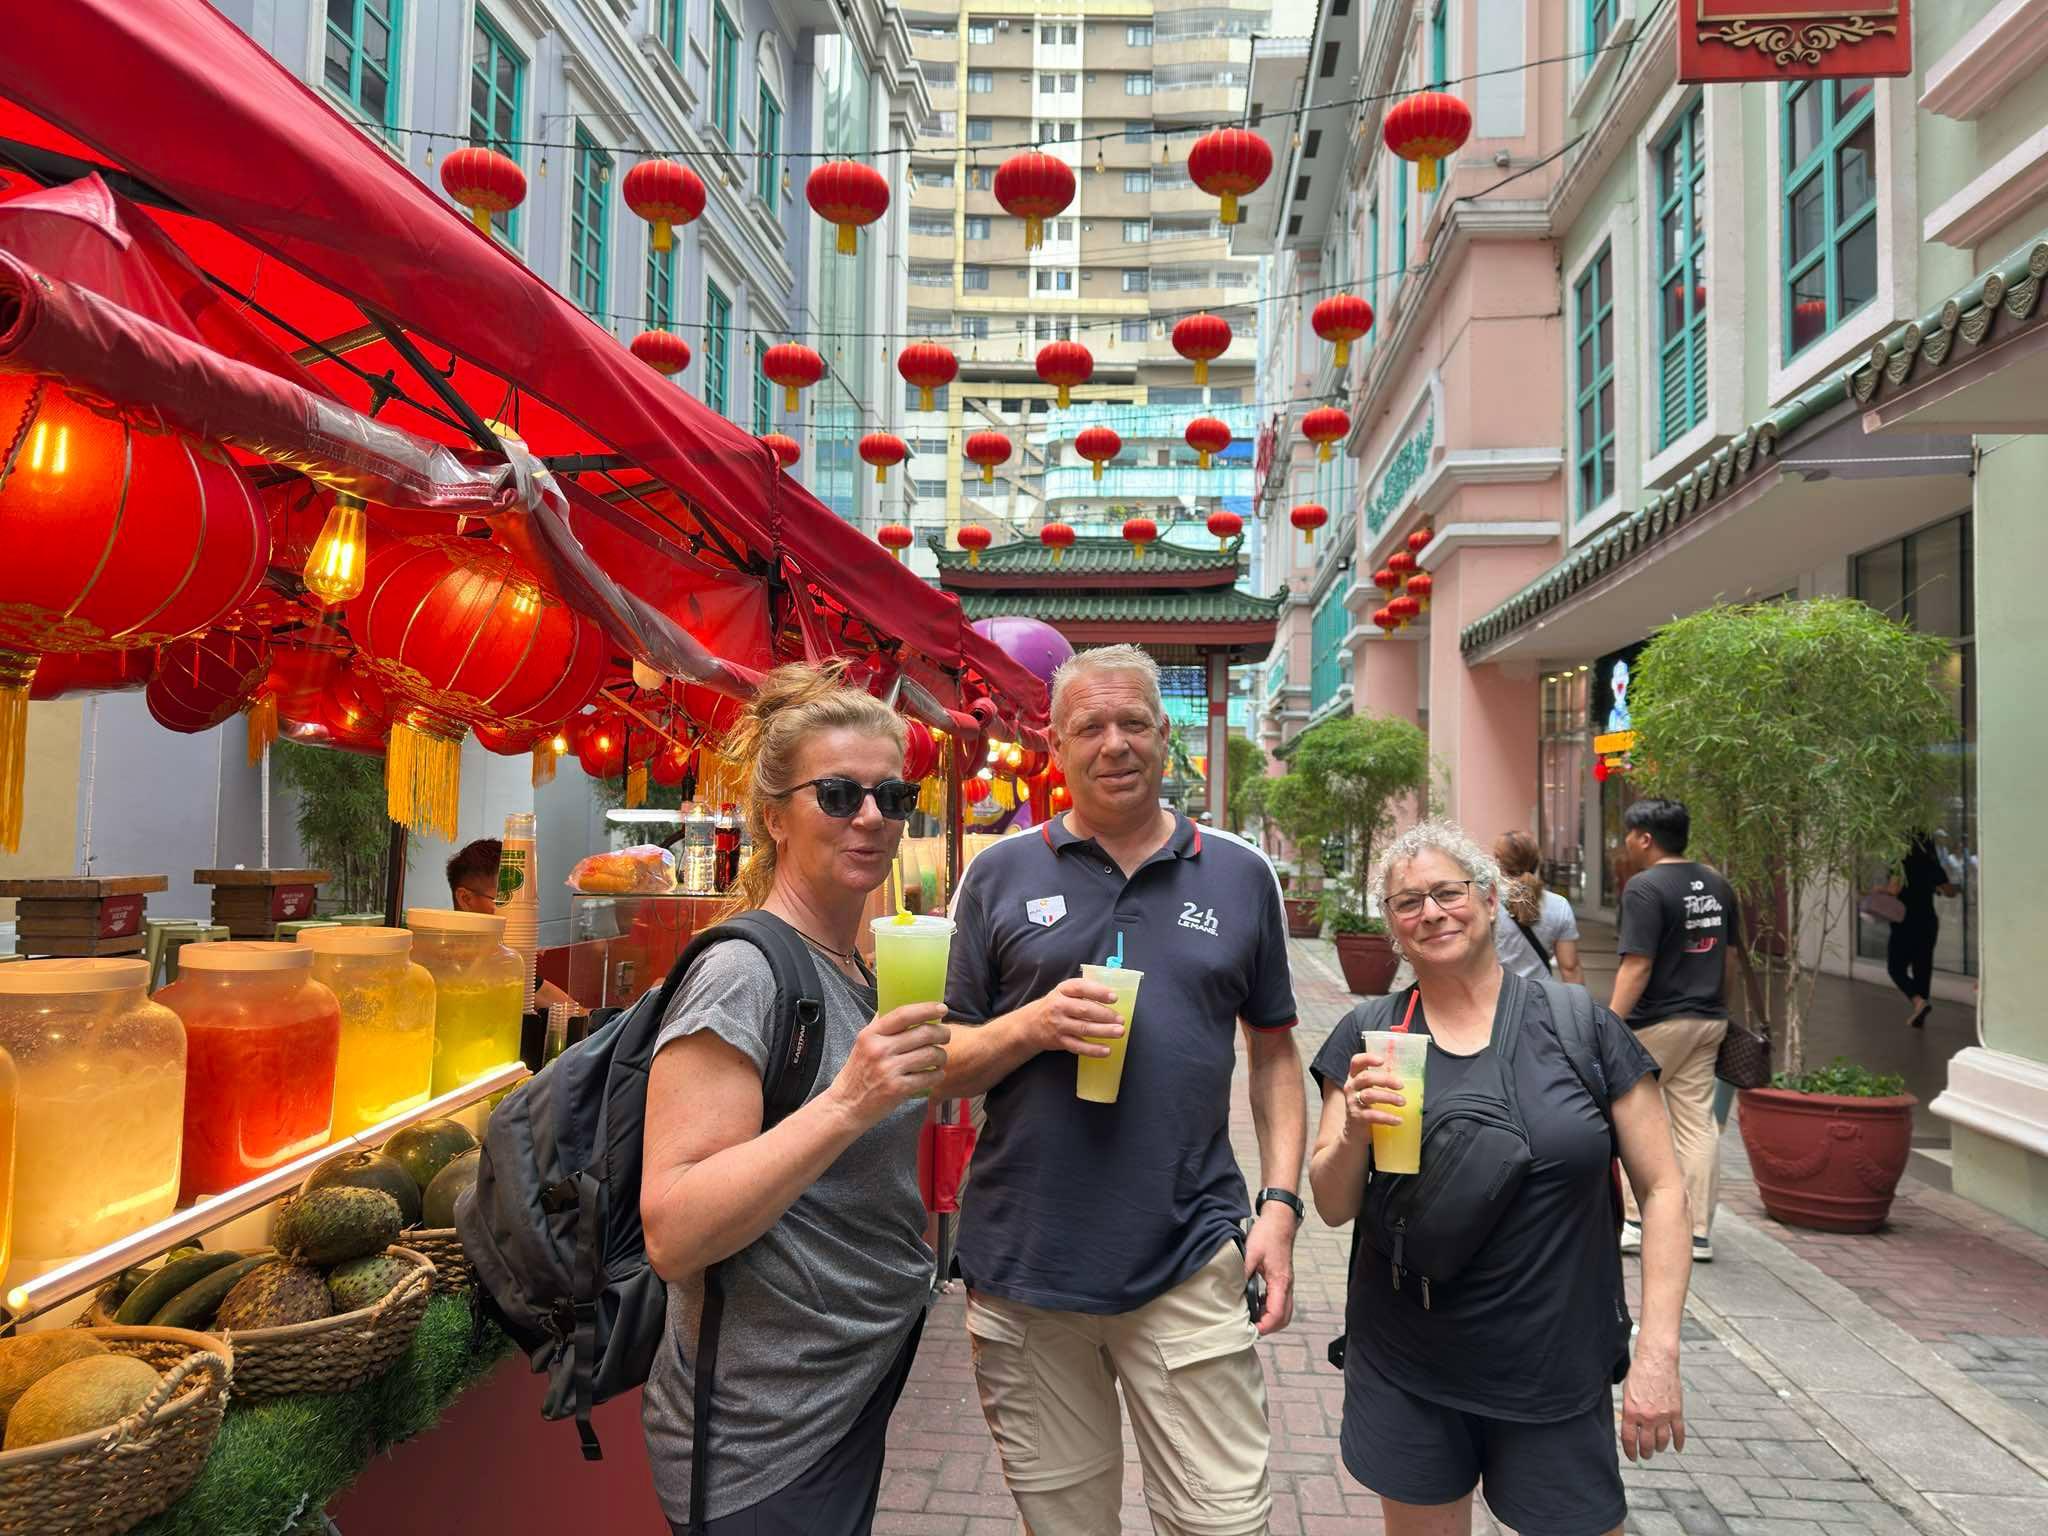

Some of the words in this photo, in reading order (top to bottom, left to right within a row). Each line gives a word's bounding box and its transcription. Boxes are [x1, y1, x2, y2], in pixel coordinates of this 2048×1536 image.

[1177, 919, 1190, 928] LE
[1190, 922, 1217, 935] MANS
[1179, 901, 1219, 929] 24h
[793, 1024, 806, 1064] EASTPAK
